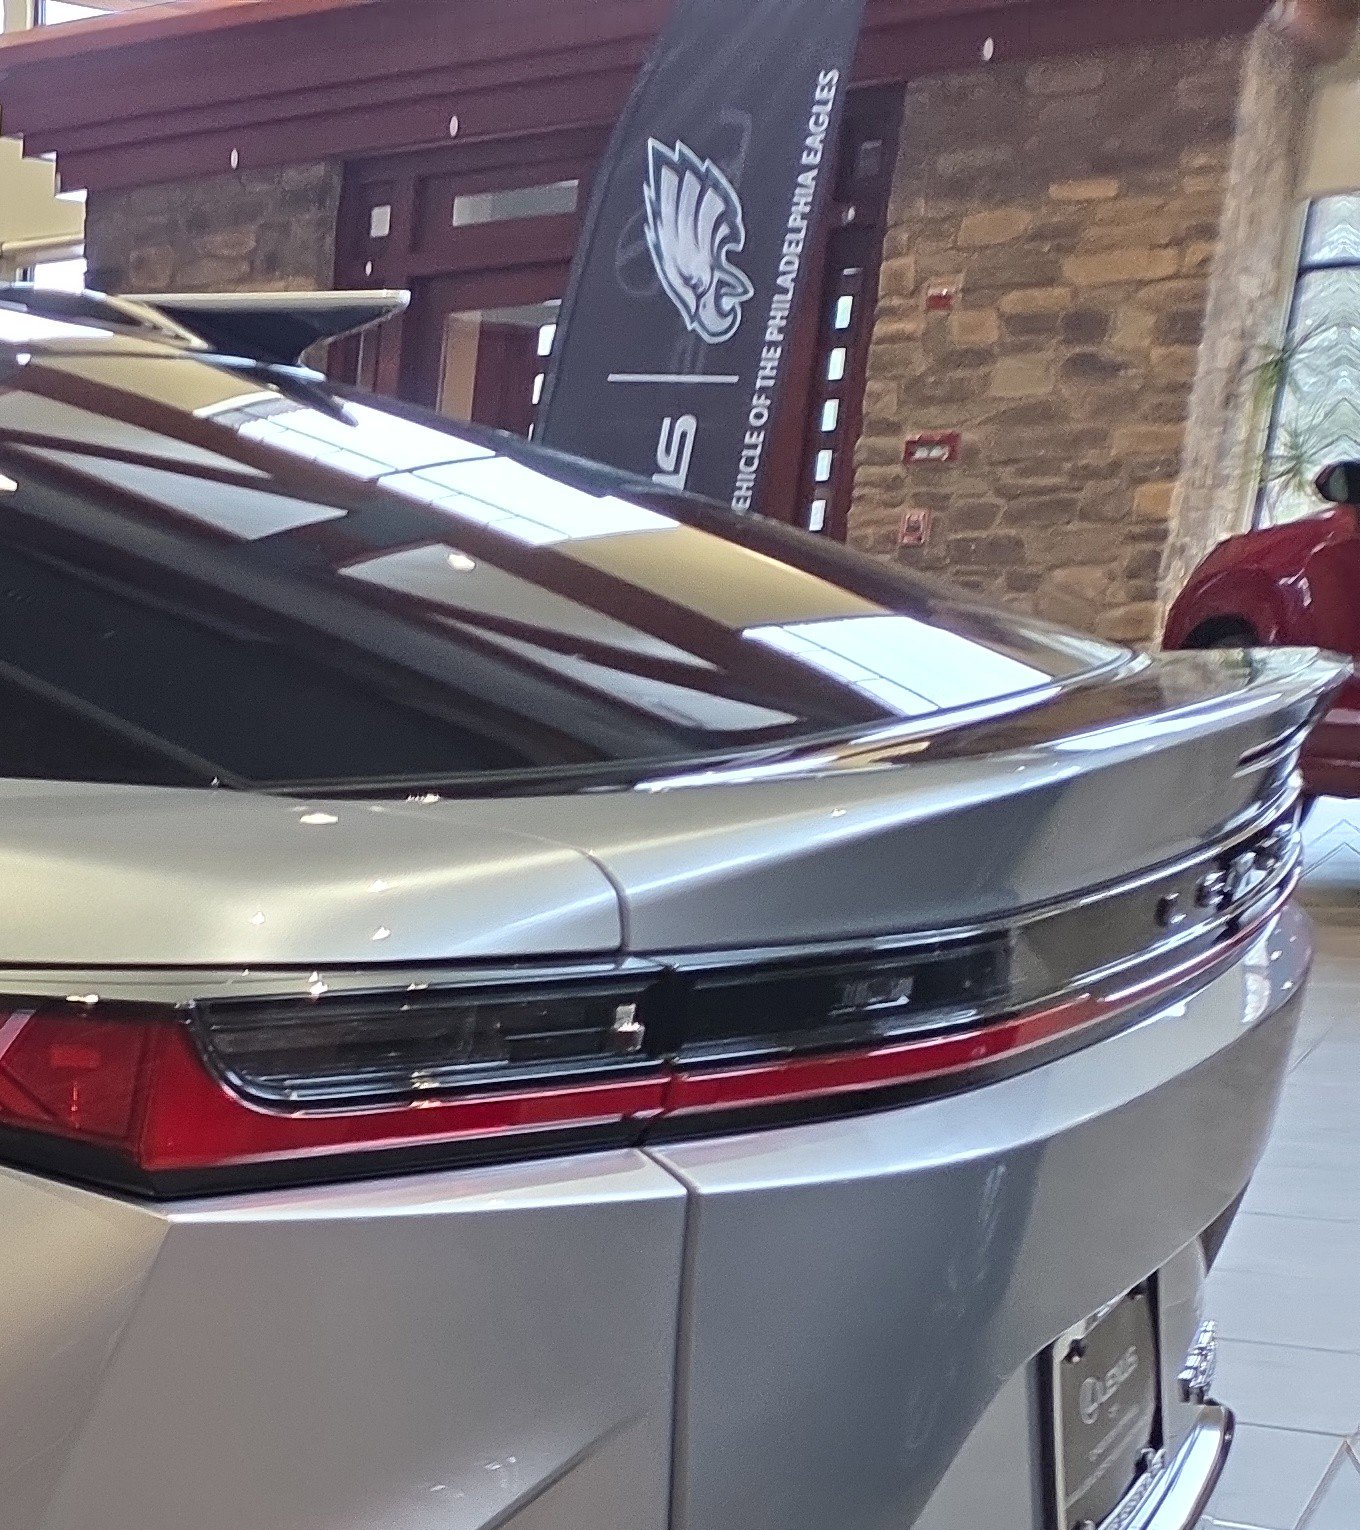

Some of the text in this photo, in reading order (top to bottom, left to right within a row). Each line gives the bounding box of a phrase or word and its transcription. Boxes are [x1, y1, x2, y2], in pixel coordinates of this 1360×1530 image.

[730, 68, 839, 516] EHICLE OF THE PHILADELPHIA EAGLES
